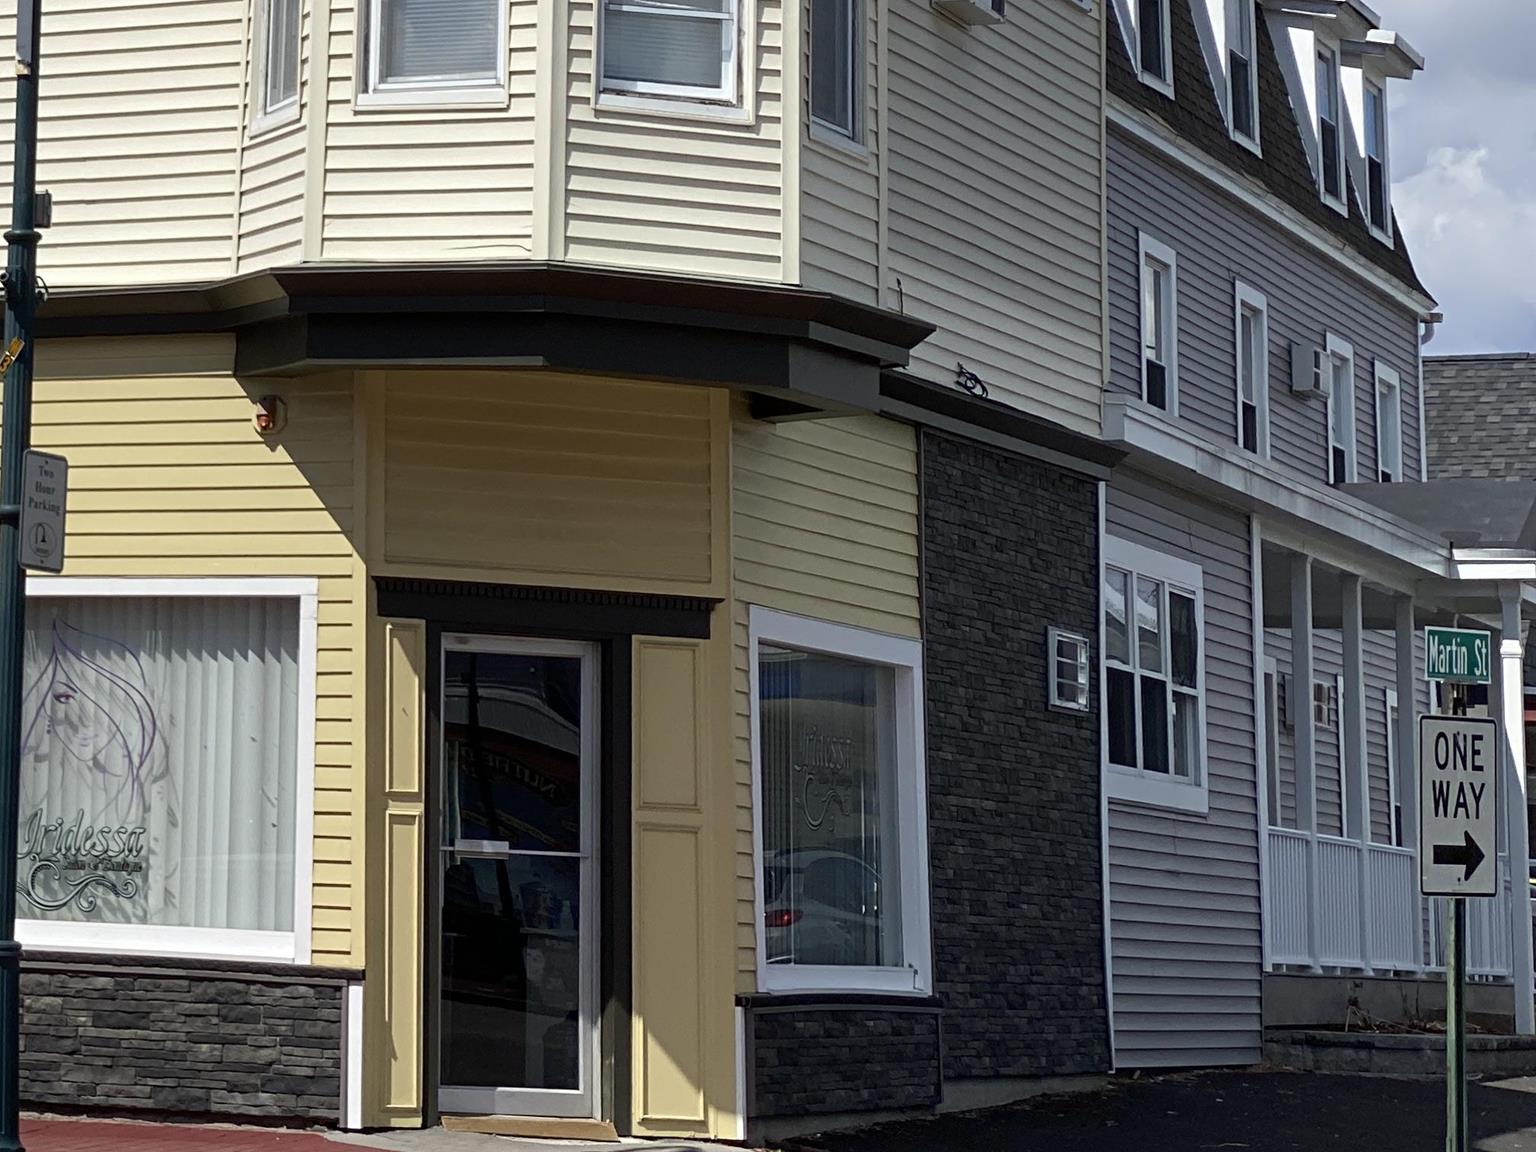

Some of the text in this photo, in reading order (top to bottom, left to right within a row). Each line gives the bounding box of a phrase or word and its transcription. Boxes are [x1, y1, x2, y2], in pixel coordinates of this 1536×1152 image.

[35, 480, 56, 495] Hour
[39, 465, 55, 479] Two
[28, 496, 61, 517] Parking
[1429, 634, 1487, 676] Martin St
[1434, 731, 1485, 771] ONE
[1432, 779, 1486, 820] WAY
[17, 808, 146, 859] Iridessa
